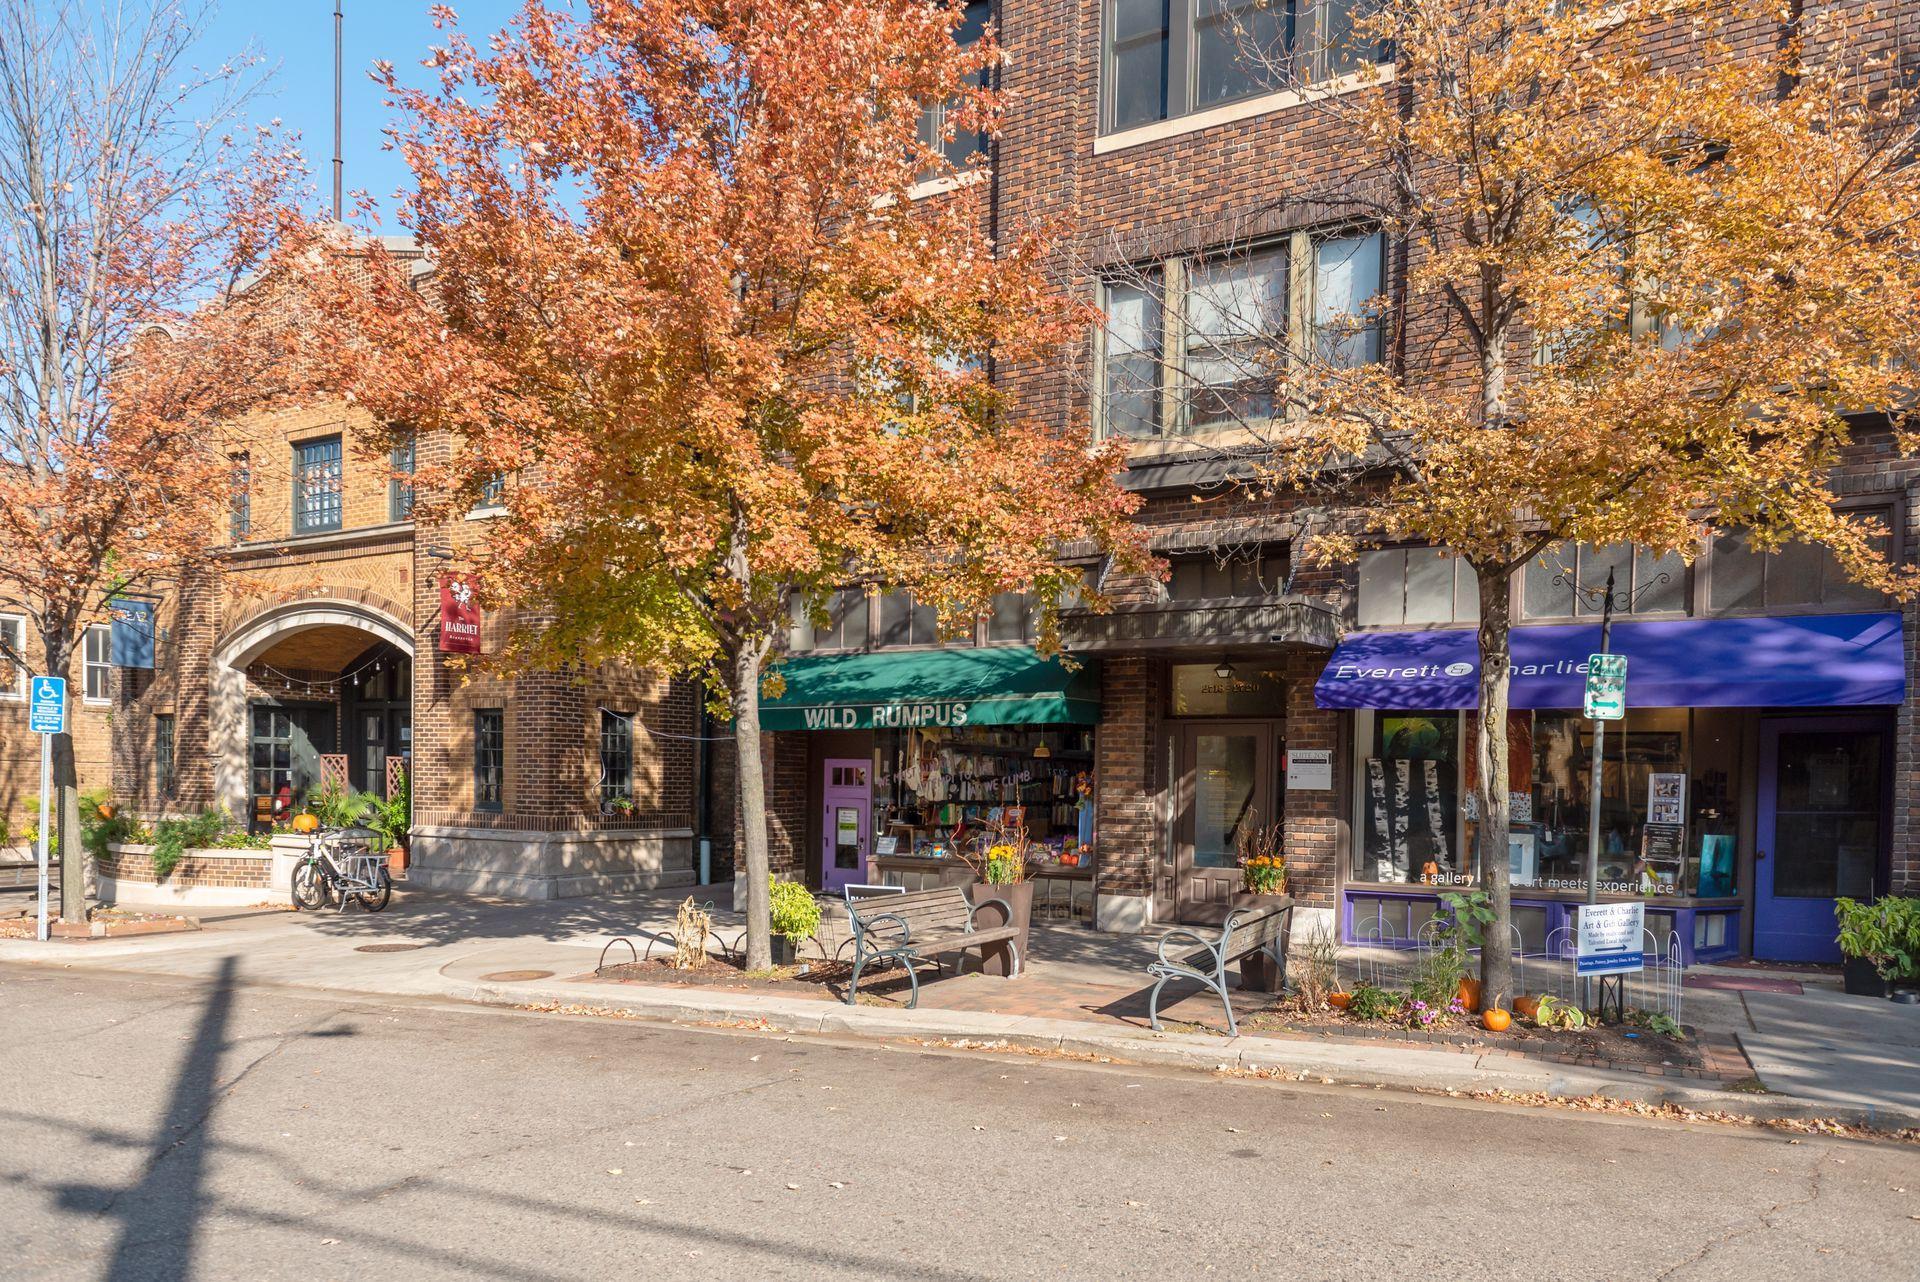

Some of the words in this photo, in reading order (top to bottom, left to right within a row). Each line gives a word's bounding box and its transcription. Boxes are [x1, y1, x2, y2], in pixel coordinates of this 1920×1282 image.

[445, 621, 478, 635] HARRIET
[1335, 664, 1440, 679] Everett
[1509, 660, 1588, 675] arlie
[804, 707, 857, 729] WILD
[872, 703, 968, 727] RUMPUS
[985, 778, 999, 792] WE
[1420, 873, 1427, 882] a
[1431, 872, 1474, 887] gallery
[1548, 878, 1588, 890] meets
[1595, 880, 1674, 894] experience
[1585, 908, 1608, 917] Everett
[1617, 906, 1639, 915] Charlie
[1583, 921, 1594, 929] Art
[1596, 920, 1601, 929] &
[1617, 919, 1639, 928] Gallery
